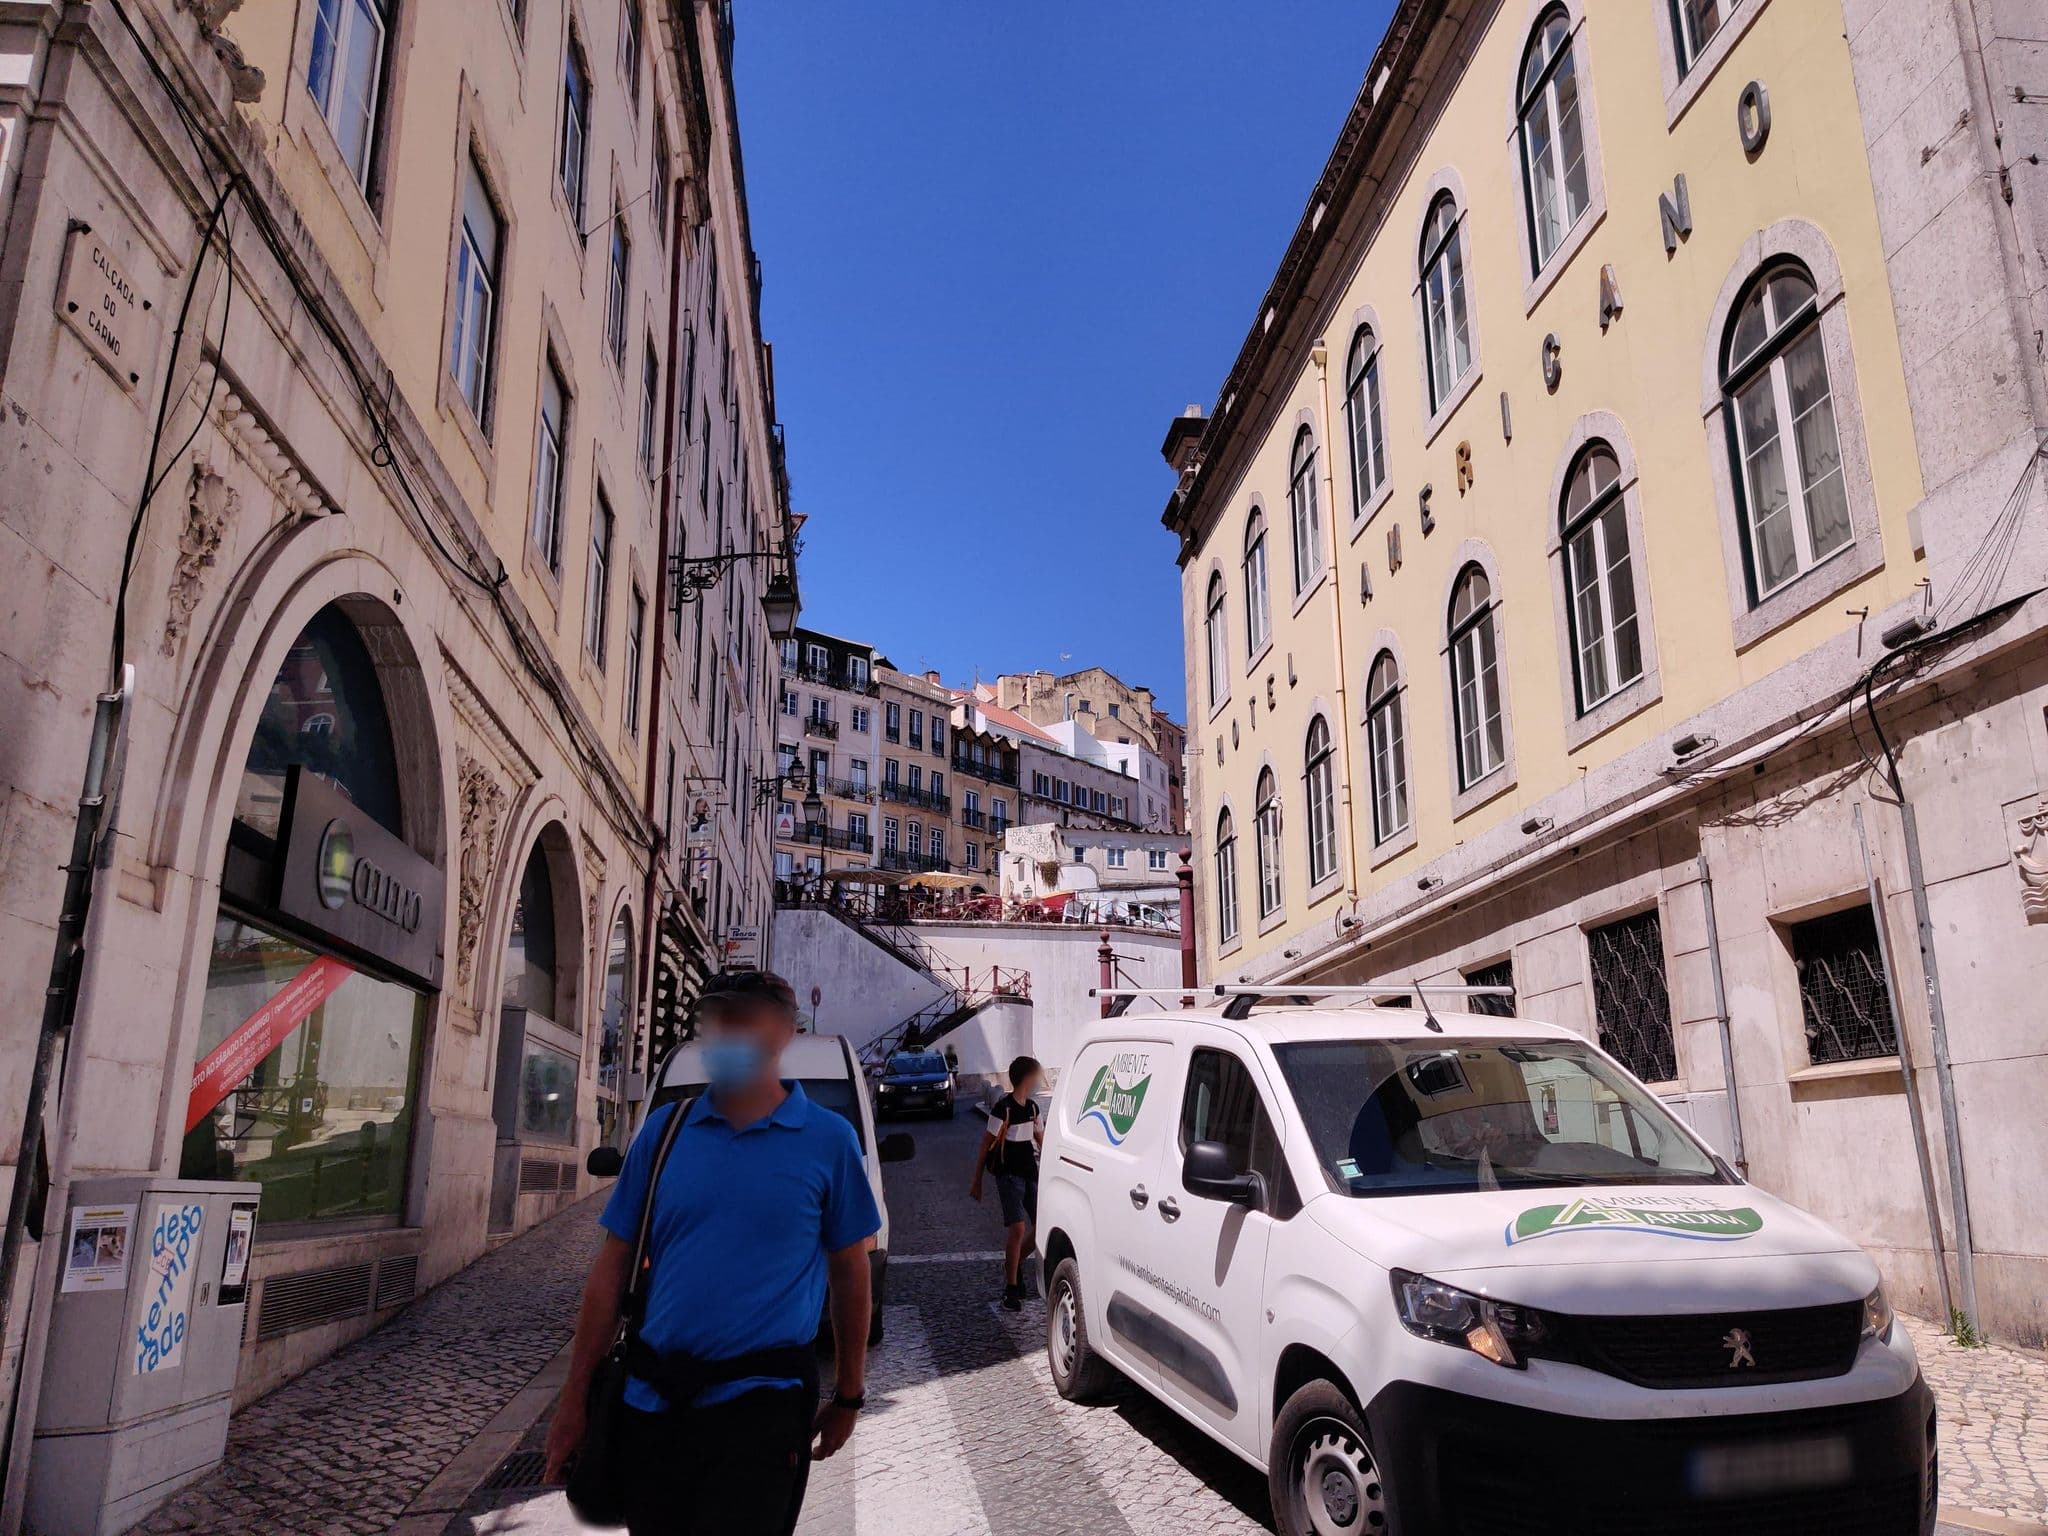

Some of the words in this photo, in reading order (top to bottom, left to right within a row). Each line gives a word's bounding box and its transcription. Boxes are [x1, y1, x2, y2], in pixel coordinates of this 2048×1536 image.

[103, 294, 117, 317] DO
[88, 311, 121, 357] CARMO
[1216, 652, 1298, 769] HOTEL
[1360, 80, 1770, 608] AMERICANO
